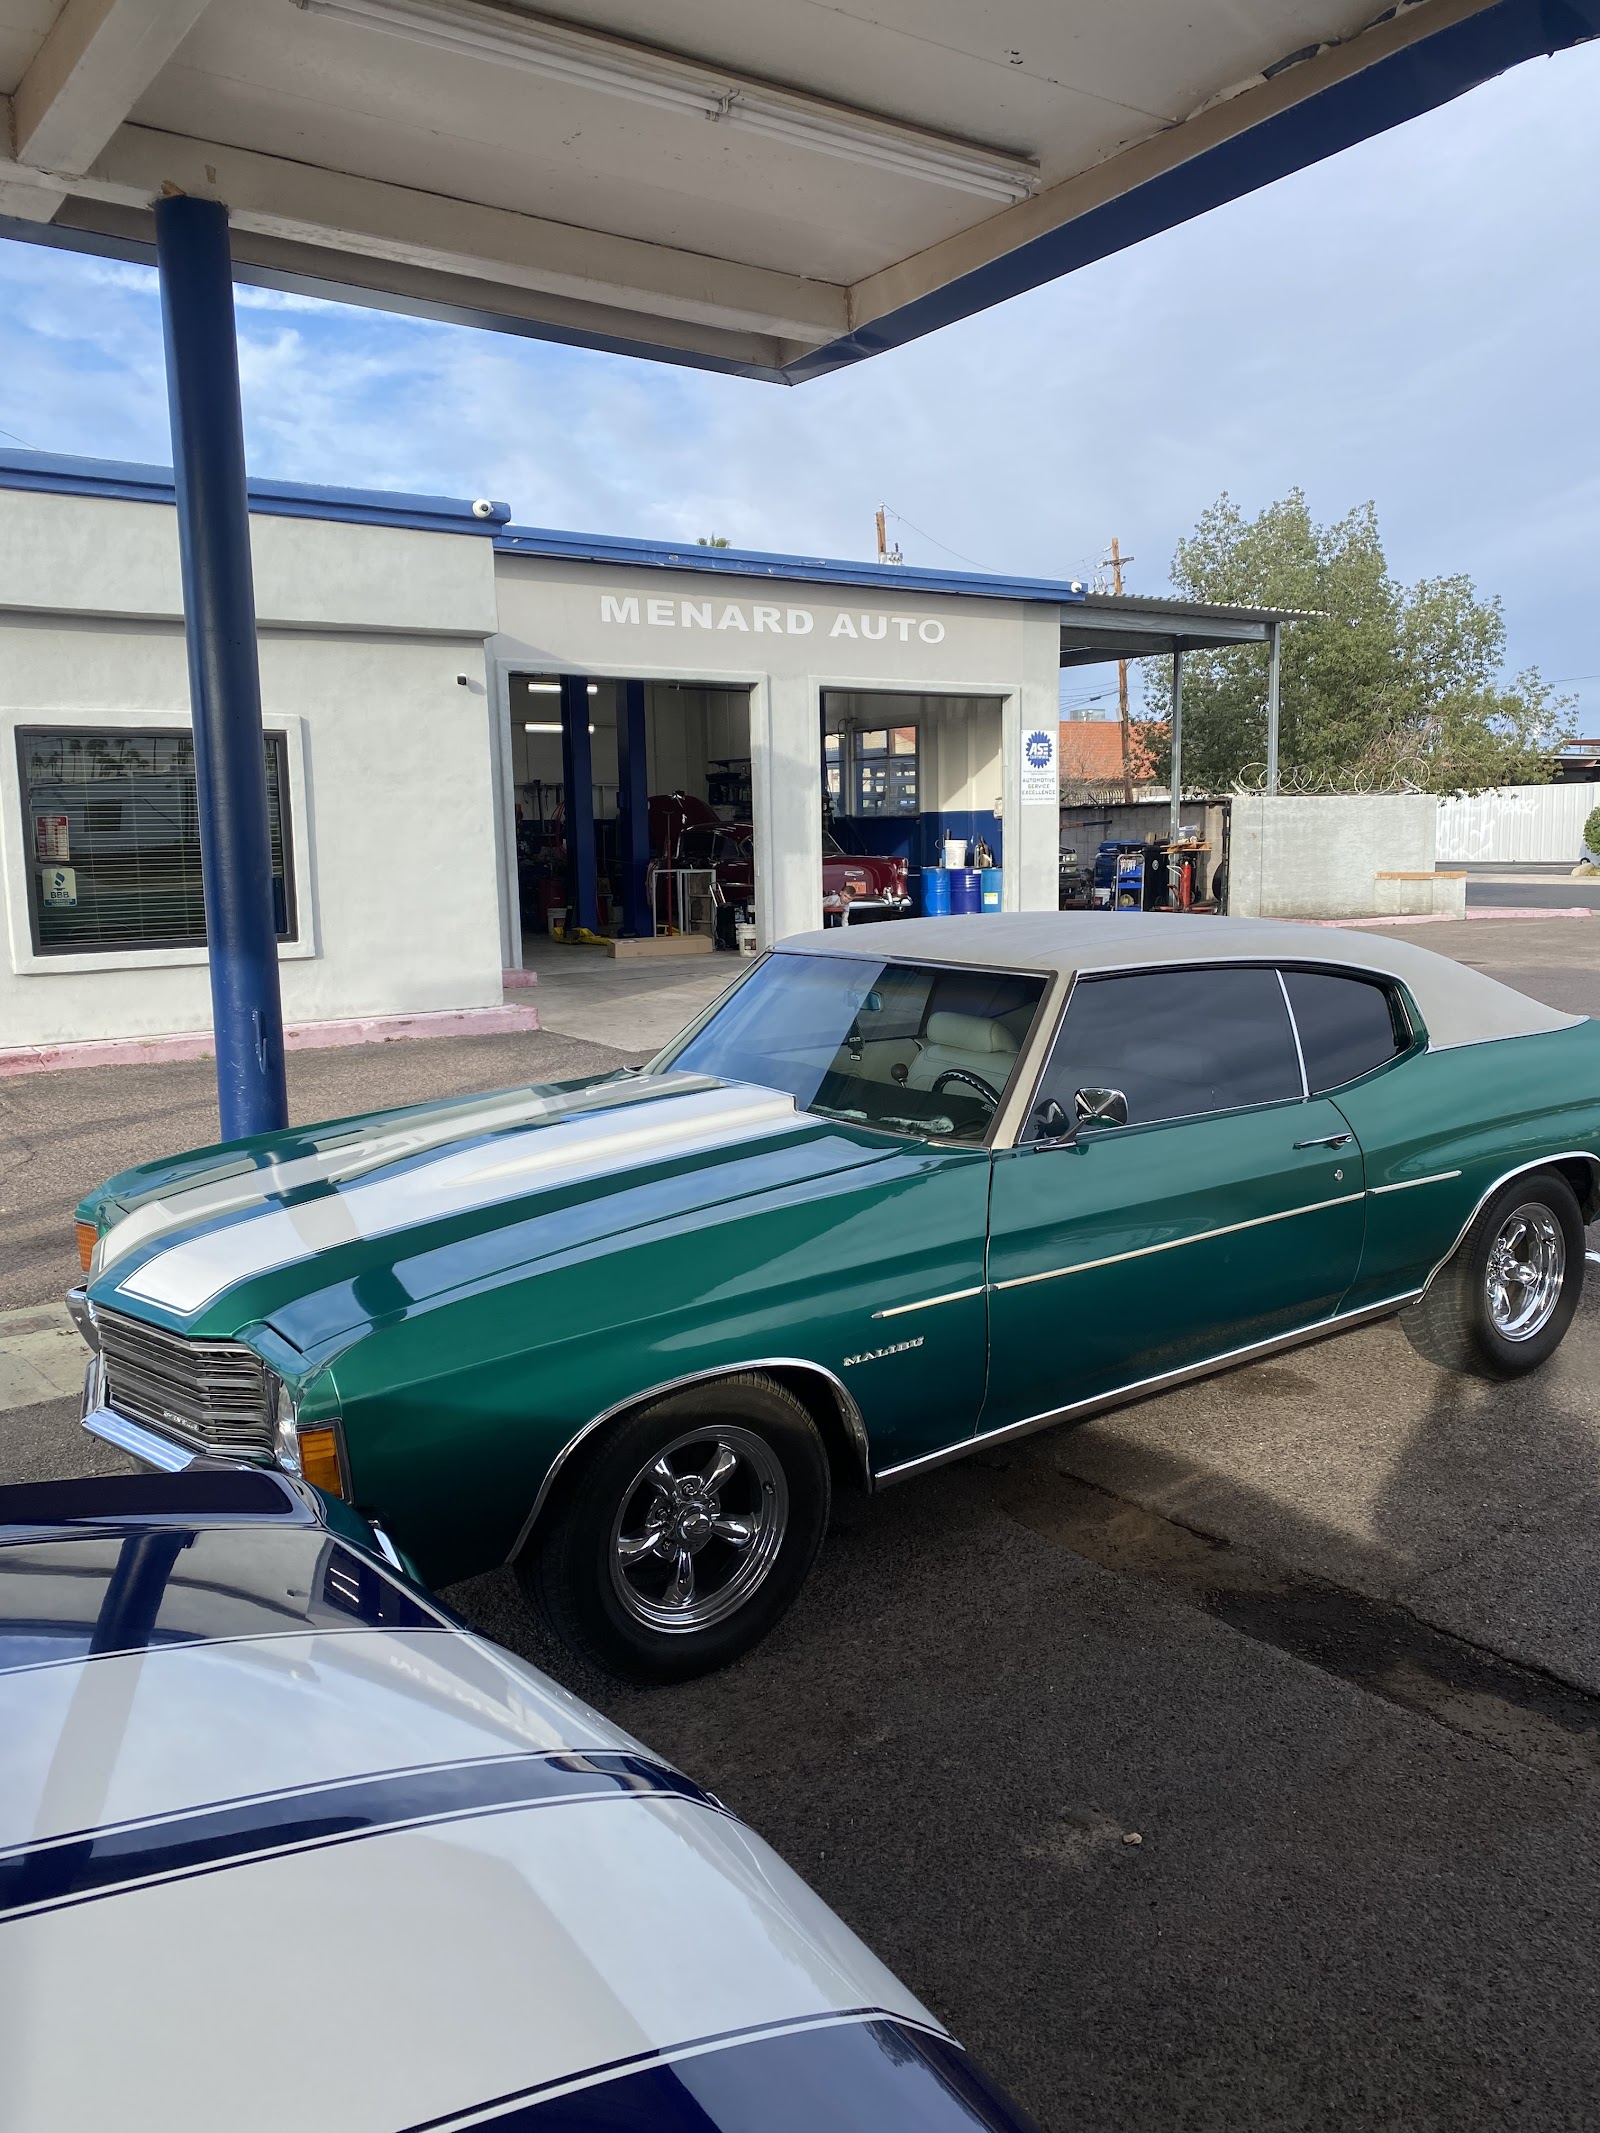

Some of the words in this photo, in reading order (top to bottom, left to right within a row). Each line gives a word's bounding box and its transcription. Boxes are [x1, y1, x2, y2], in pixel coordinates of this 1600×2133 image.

[600, 595, 814, 635] MENARD
[829, 612, 946, 644] AUTO
[1028, 742, 1049, 755] ASE
[843, 1335, 924, 1367] MALIBU
